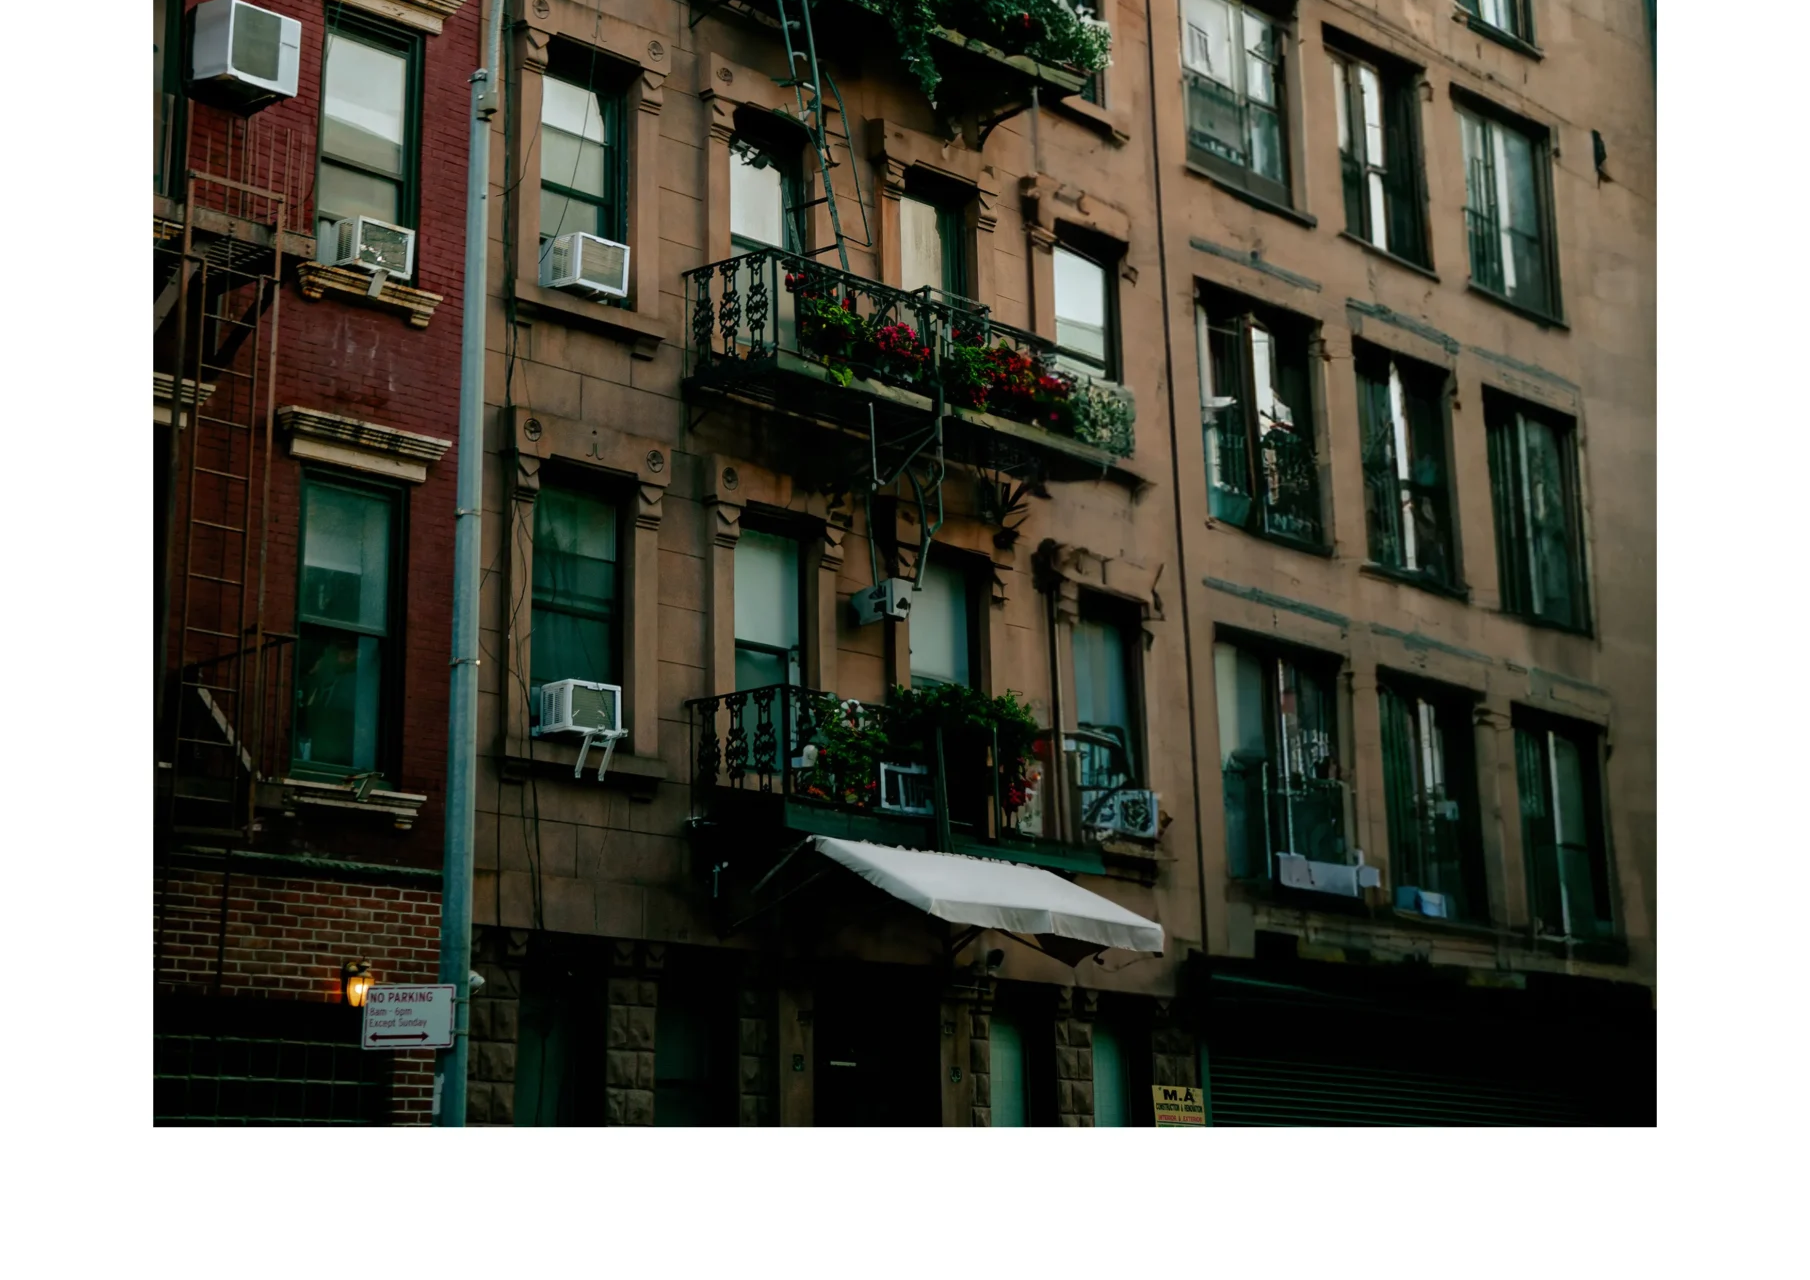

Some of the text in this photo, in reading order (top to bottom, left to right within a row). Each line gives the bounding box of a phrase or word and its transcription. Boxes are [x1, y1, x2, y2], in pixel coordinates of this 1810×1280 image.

[370, 991, 434, 1003] NO PARKING
[369, 1007, 387, 1016] 8am
[395, 1007, 412, 1016] 6pm
[369, 1017, 427, 1028] Except Sunday
